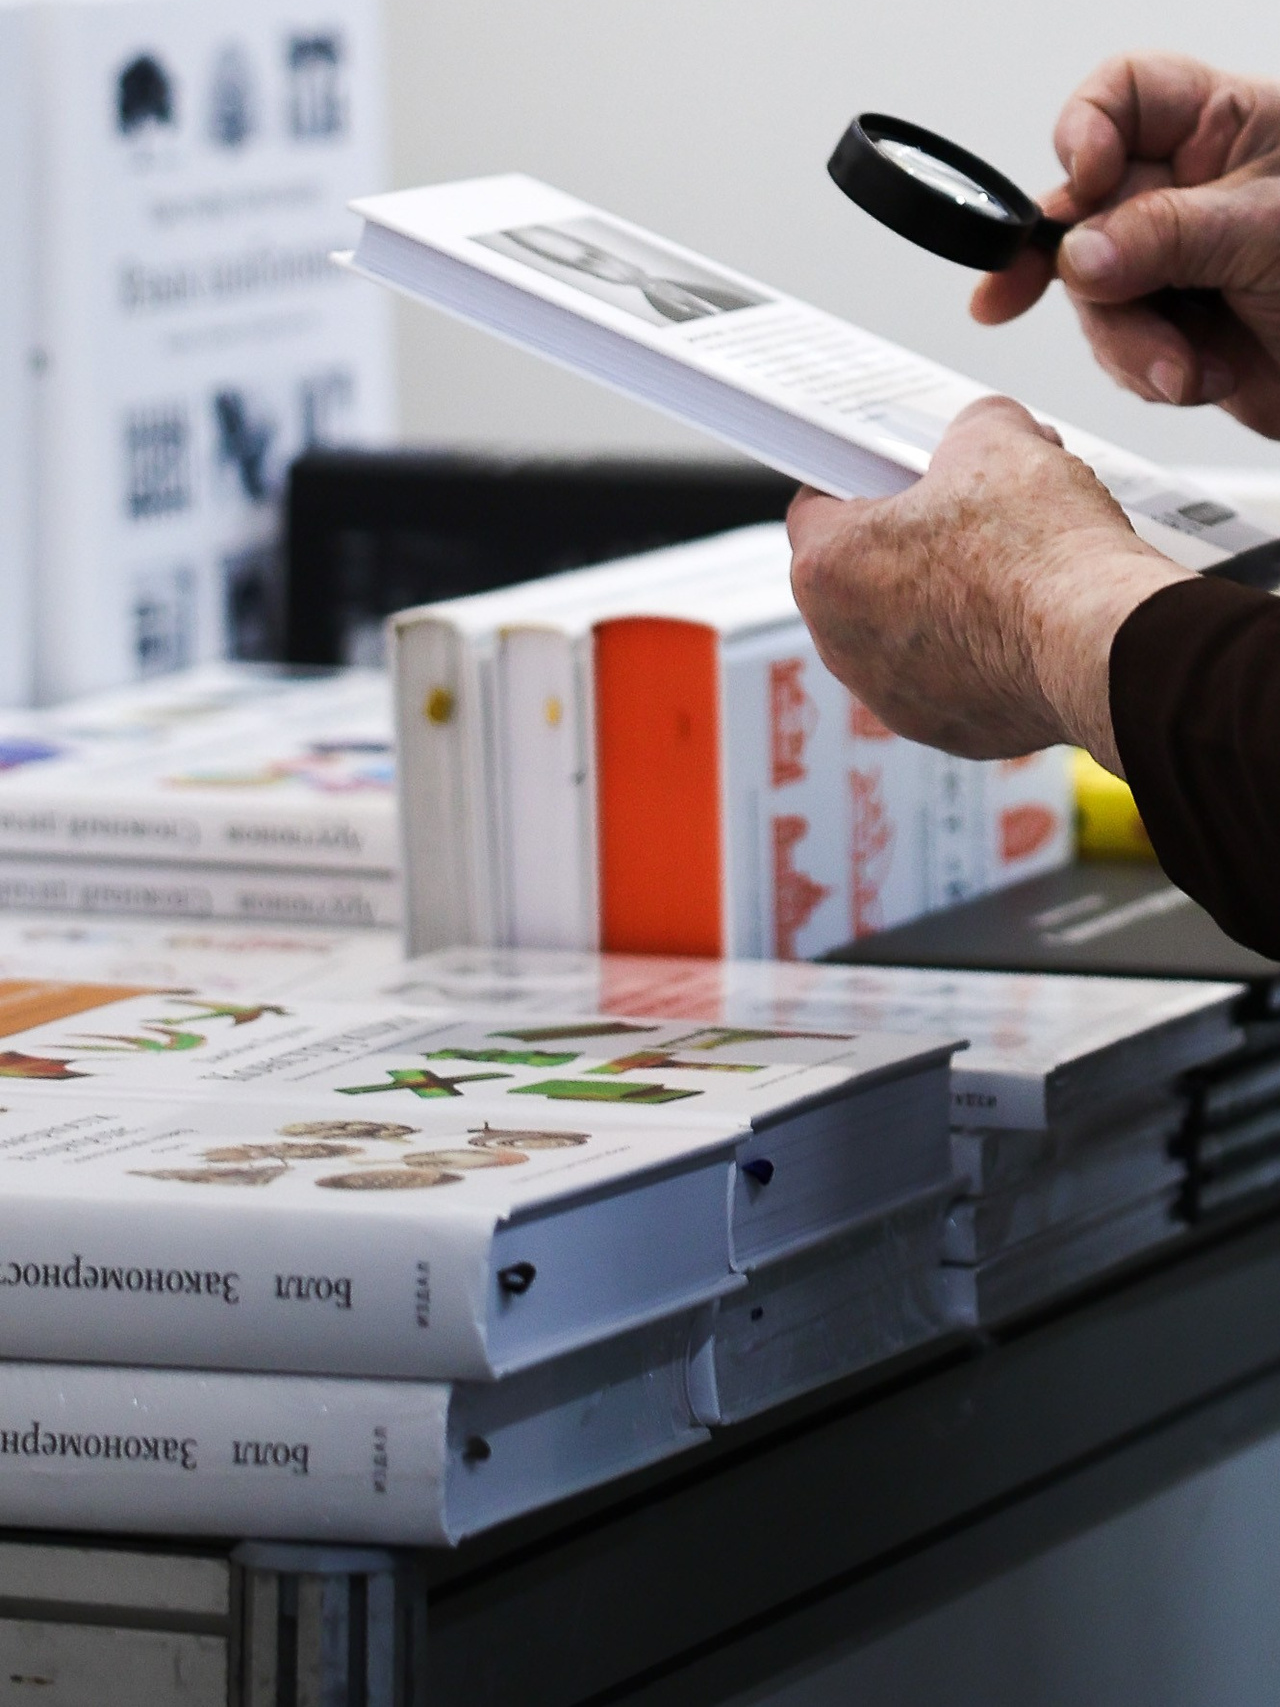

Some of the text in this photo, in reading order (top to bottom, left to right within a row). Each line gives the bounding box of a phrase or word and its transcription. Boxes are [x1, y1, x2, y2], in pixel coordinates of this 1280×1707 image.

[275, 1273, 354, 1310] Болл
[0, 1420, 310, 1475] Болл Закономерн
